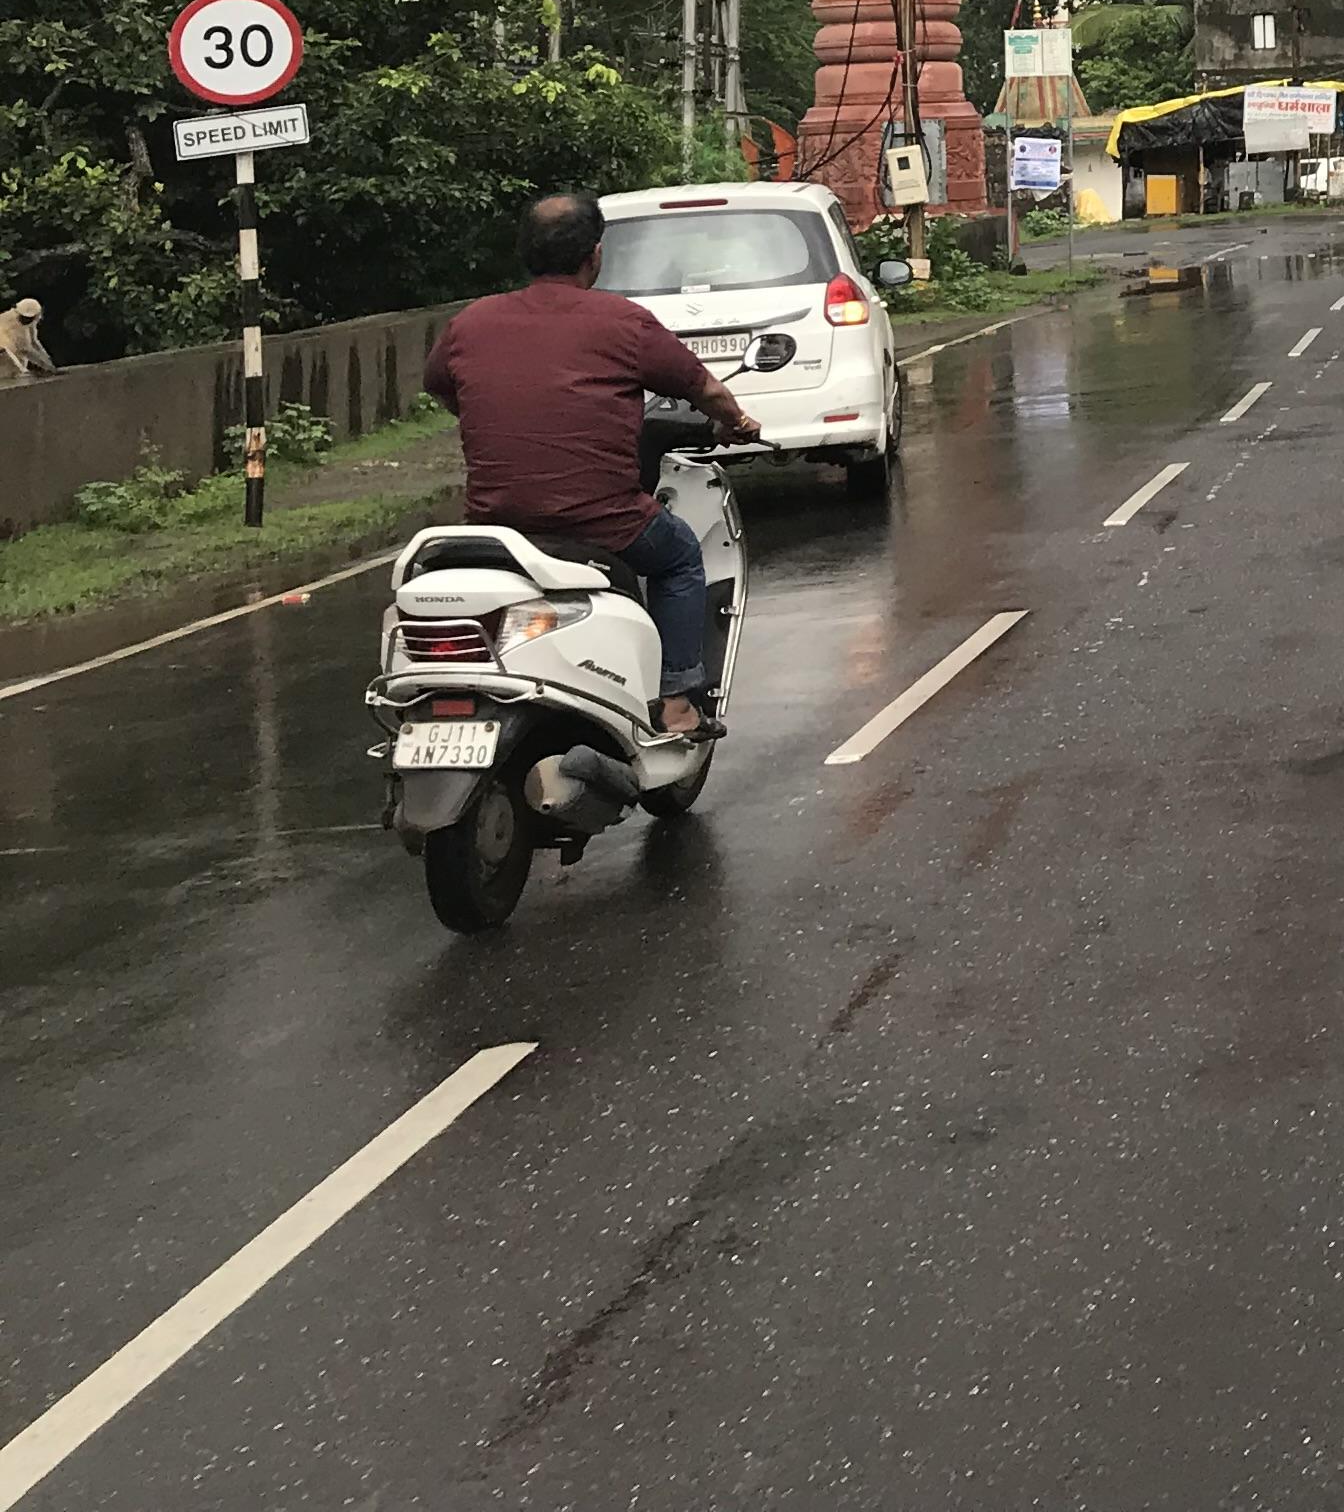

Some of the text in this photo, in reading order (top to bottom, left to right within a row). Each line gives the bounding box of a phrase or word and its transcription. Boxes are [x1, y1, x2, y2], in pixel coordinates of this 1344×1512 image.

[203, 24, 274, 69] 30
[1278, 99, 1331, 113] धर्मशाला
[183, 118, 299, 147] SPEED LIMIT
[428, 725, 477, 744] GJ11
[410, 745, 488, 765] AN7330
